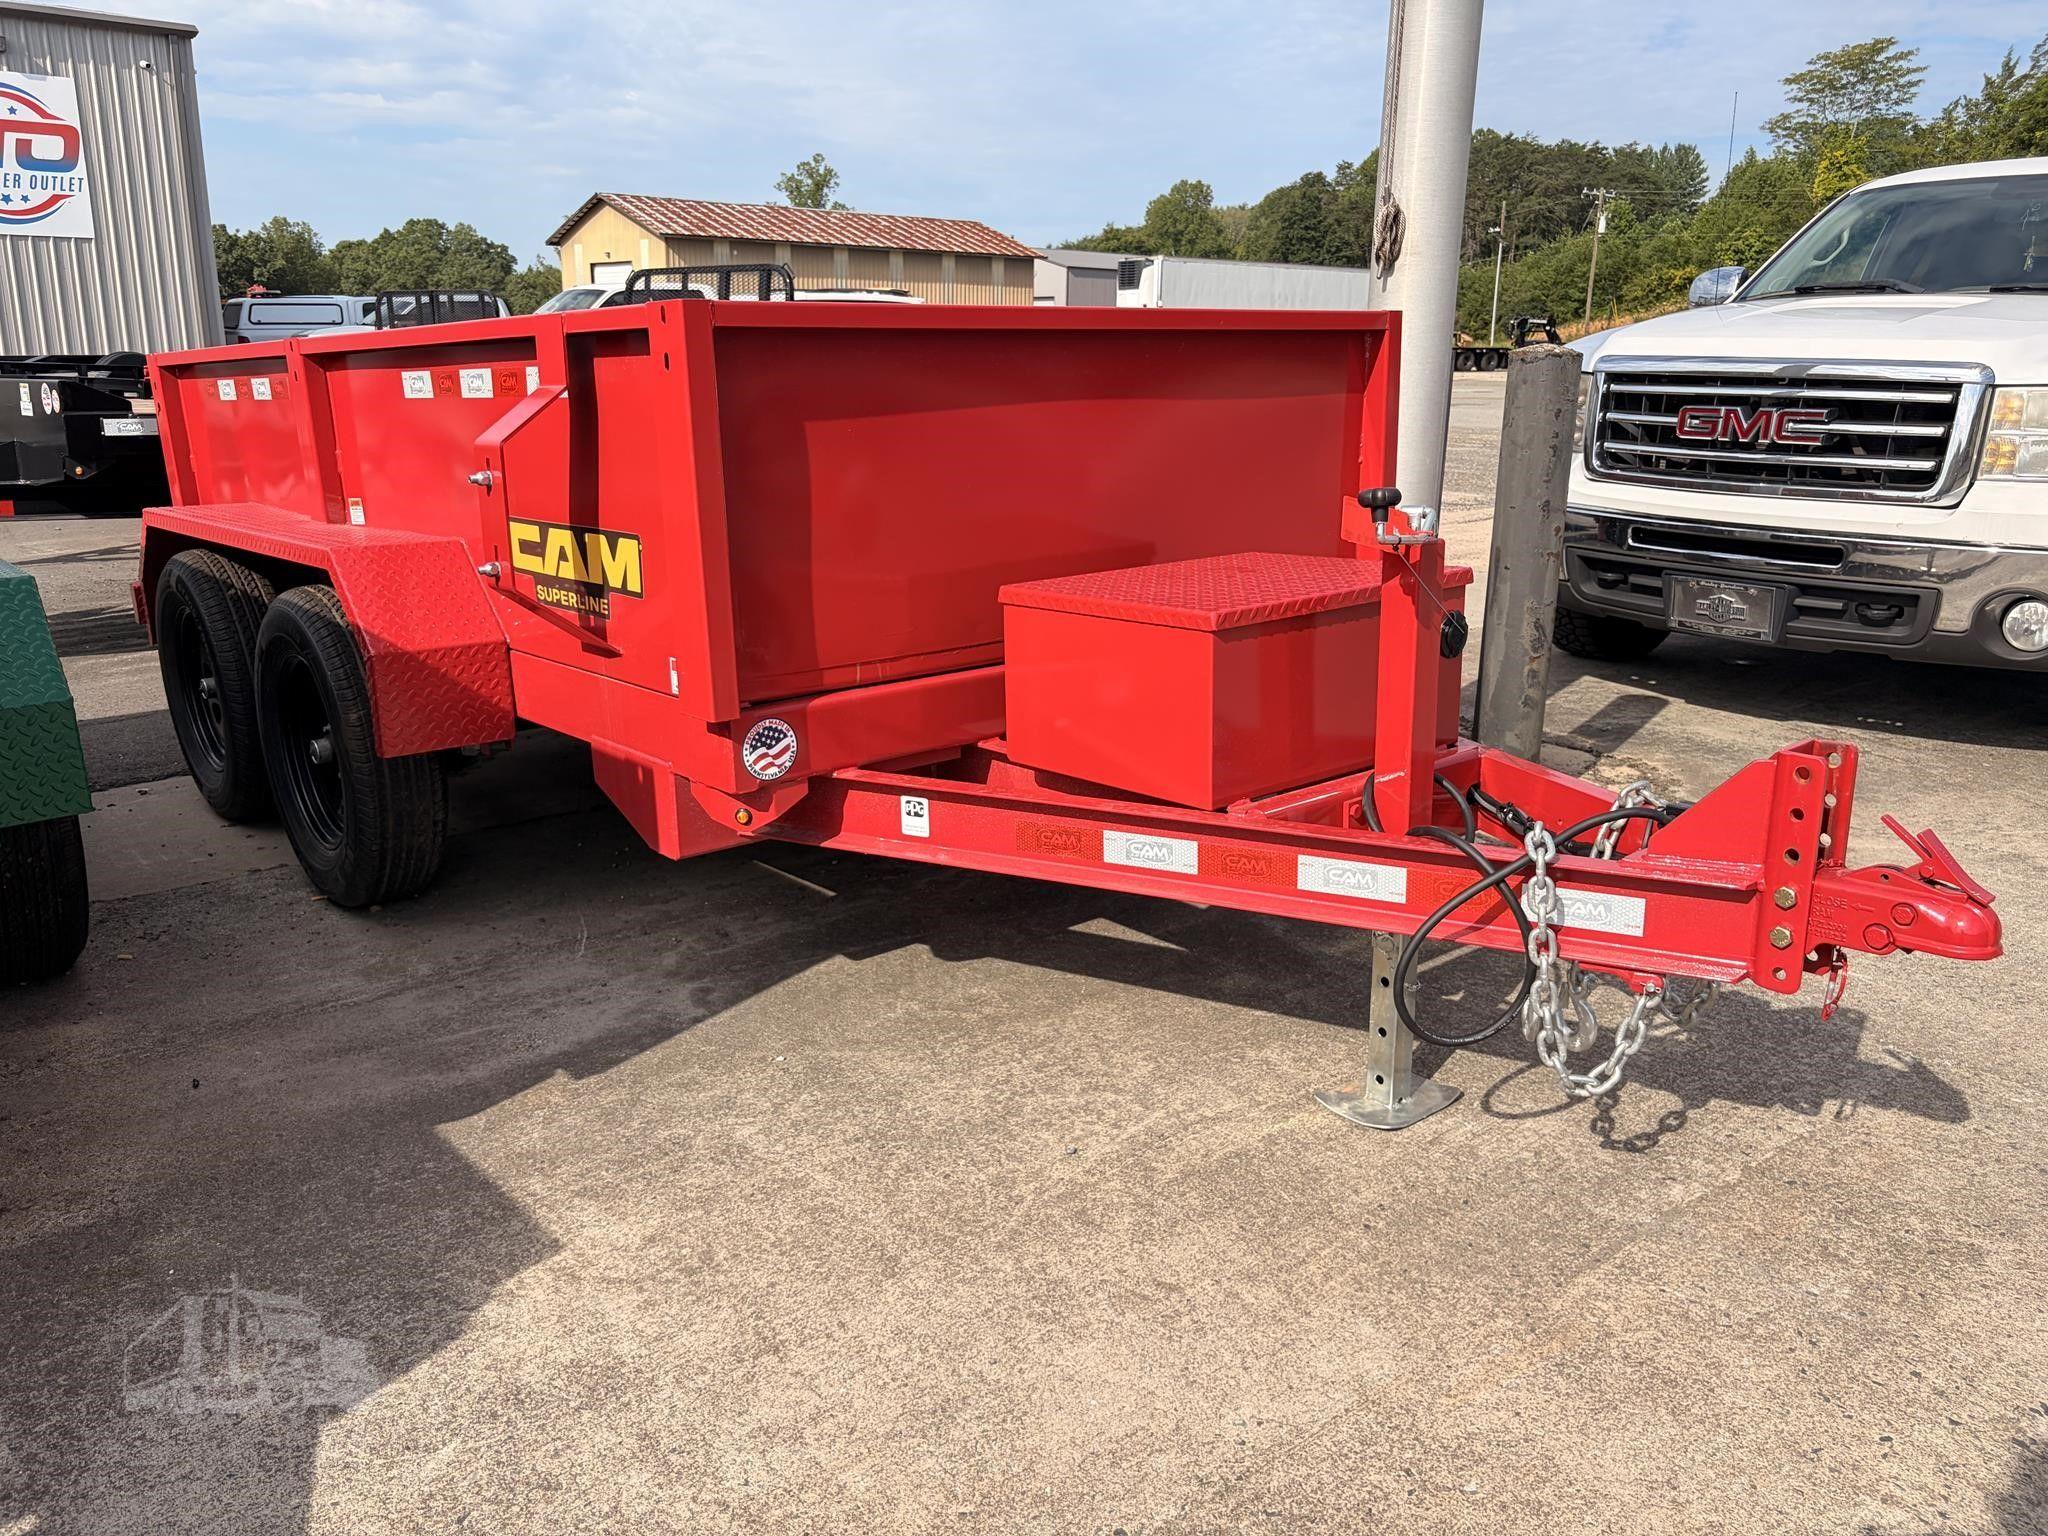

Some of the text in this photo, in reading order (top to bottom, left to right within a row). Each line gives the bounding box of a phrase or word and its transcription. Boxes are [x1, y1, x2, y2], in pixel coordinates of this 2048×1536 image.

[29, 174, 84, 193] OUTLET
[1677, 406, 1830, 446] GMC
[509, 521, 642, 593] CAM
[537, 585, 609, 615] SUPERLINE
[905, 800, 925, 817] PPG
[1040, 831, 1079, 849] CAM
[1130, 843, 1170, 861] CAM
[1226, 856, 1266, 874] CAM
[1328, 868, 1375, 889] CAM
[1813, 892, 1848, 910] CLOSE
